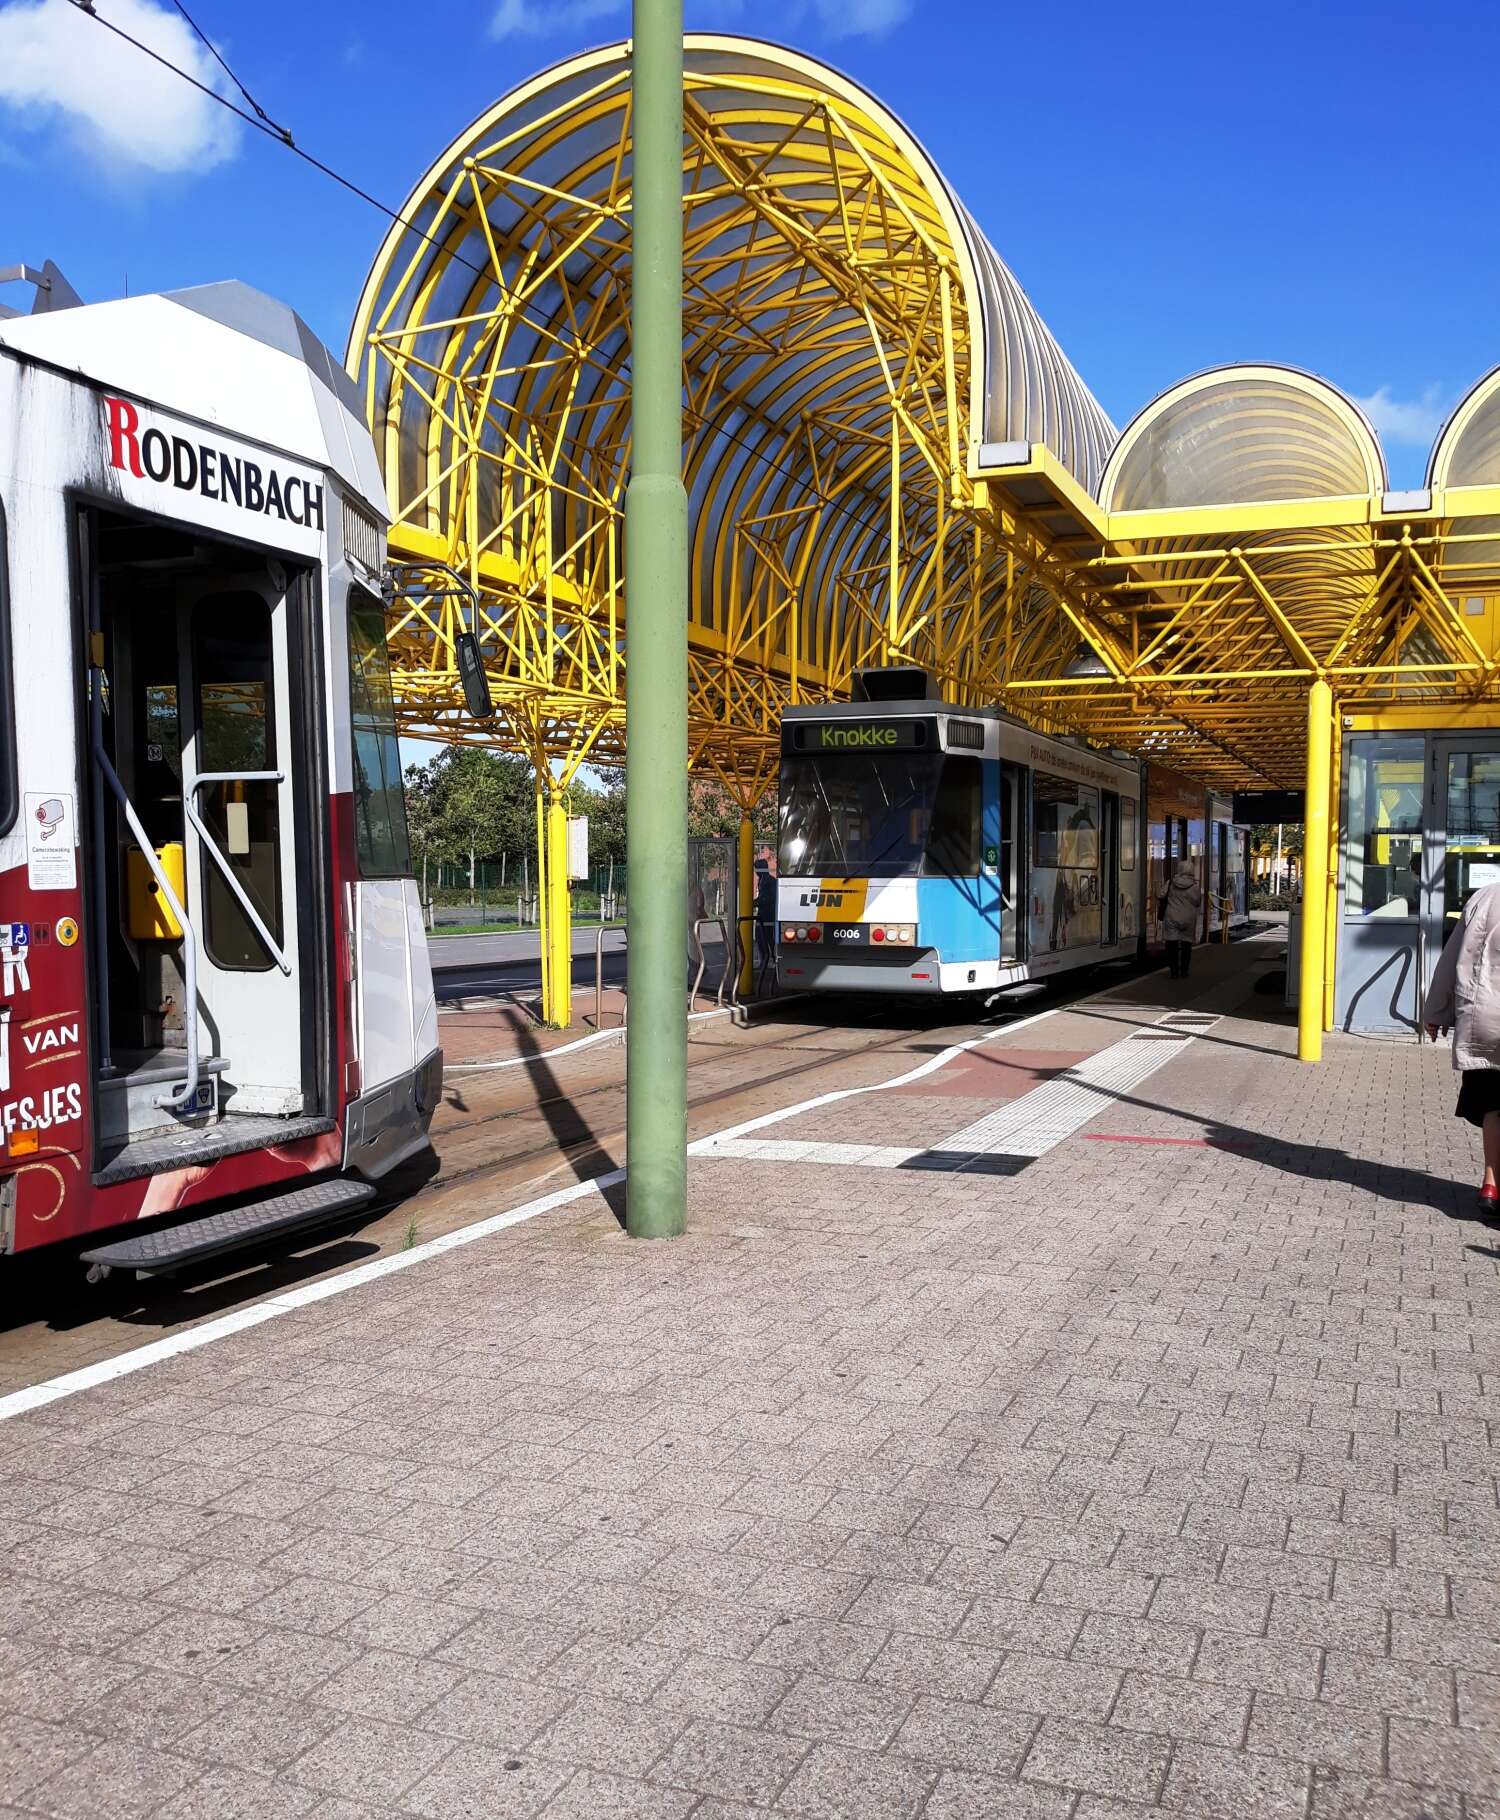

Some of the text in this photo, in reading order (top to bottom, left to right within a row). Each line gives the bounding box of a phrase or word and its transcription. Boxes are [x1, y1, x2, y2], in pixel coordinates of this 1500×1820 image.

[821, 725, 898, 746] Knokke
[833, 929, 860, 939] 6006
[23, 1023, 79, 1054] VAN
